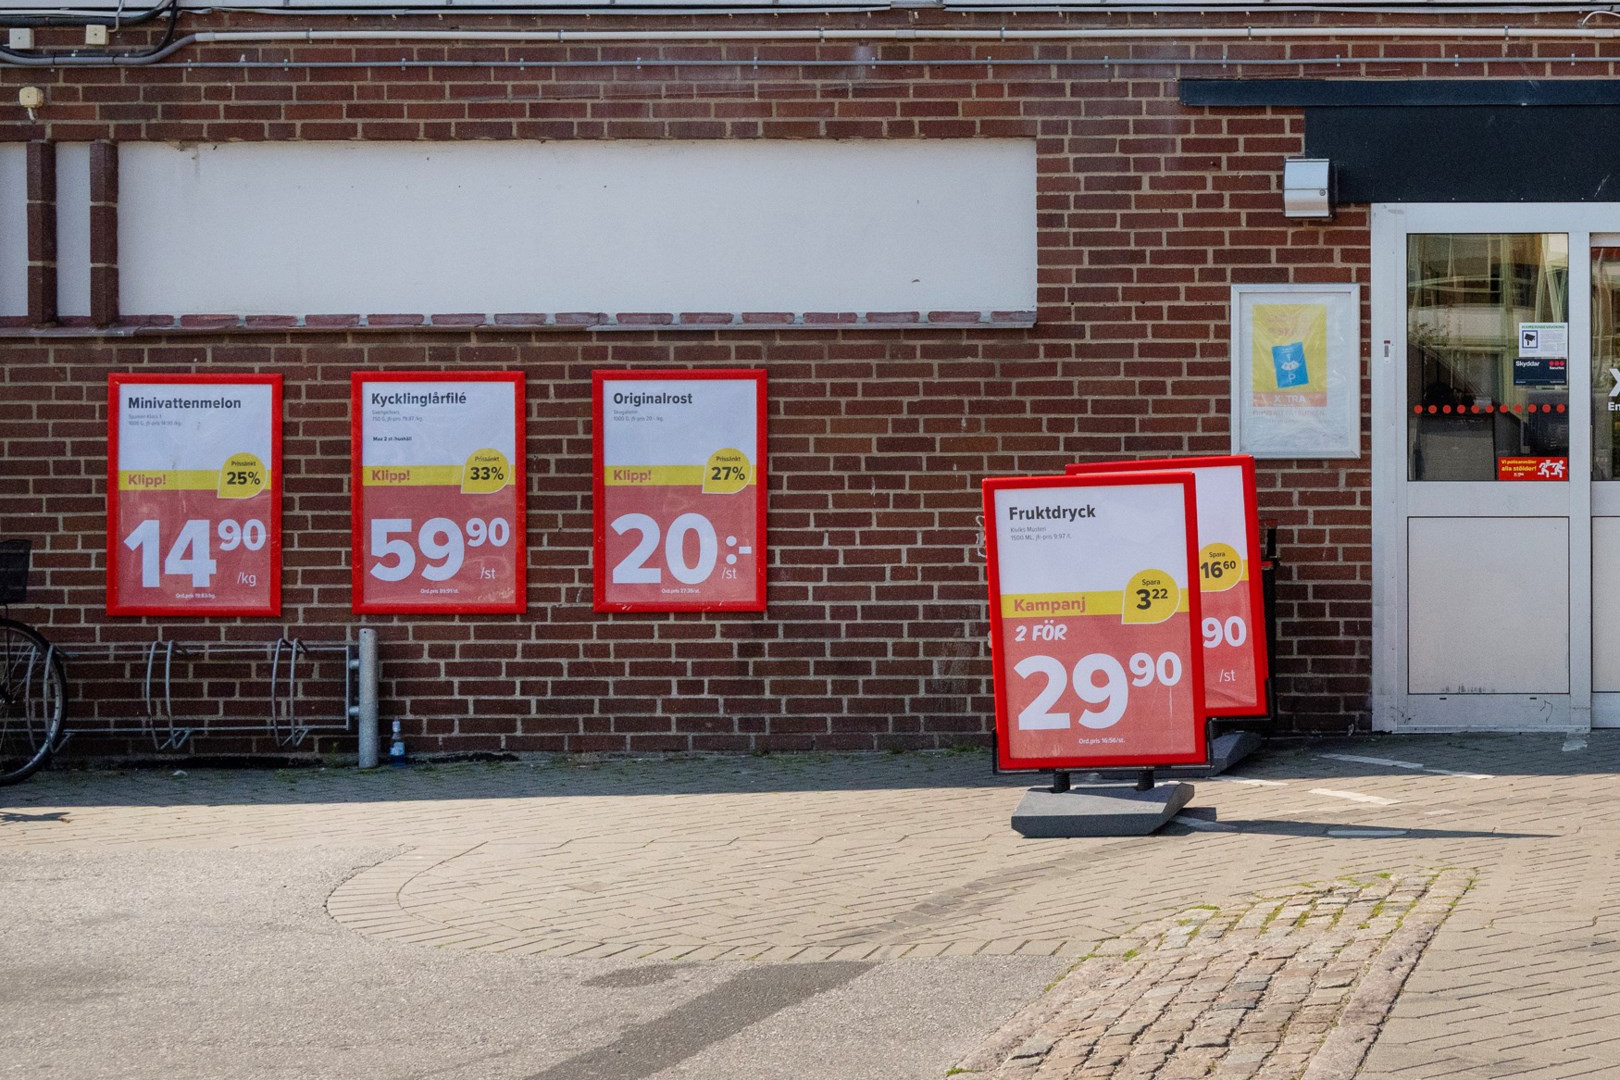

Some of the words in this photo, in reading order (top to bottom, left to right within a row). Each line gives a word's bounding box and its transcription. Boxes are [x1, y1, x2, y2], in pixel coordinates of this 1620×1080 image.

[128, 397, 242, 409] Minivattenmelon
[371, 392, 467, 407] Kycklinglårfilé
[613, 392, 693, 407] Originalrost
[1607, 402, 1620, 411] En
[226, 472, 261, 485] 25%
[372, 470, 410, 483] Klipp!
[470, 467, 504, 481] 33%
[613, 470, 651, 483] Klipp!
[711, 466, 745, 481] 27%
[128, 474, 166, 488] Klipp!
[1009, 504, 1096, 522] Fruktdryck
[237, 572, 257, 587] /kg
[480, 567, 496, 580] /st
[722, 567, 737, 580] /st
[1014, 597, 1086, 613] Kampanj
[1015, 627, 1027, 641] 2
[1032, 620, 1067, 641] FÖR
[1219, 669, 1236, 682] /st
